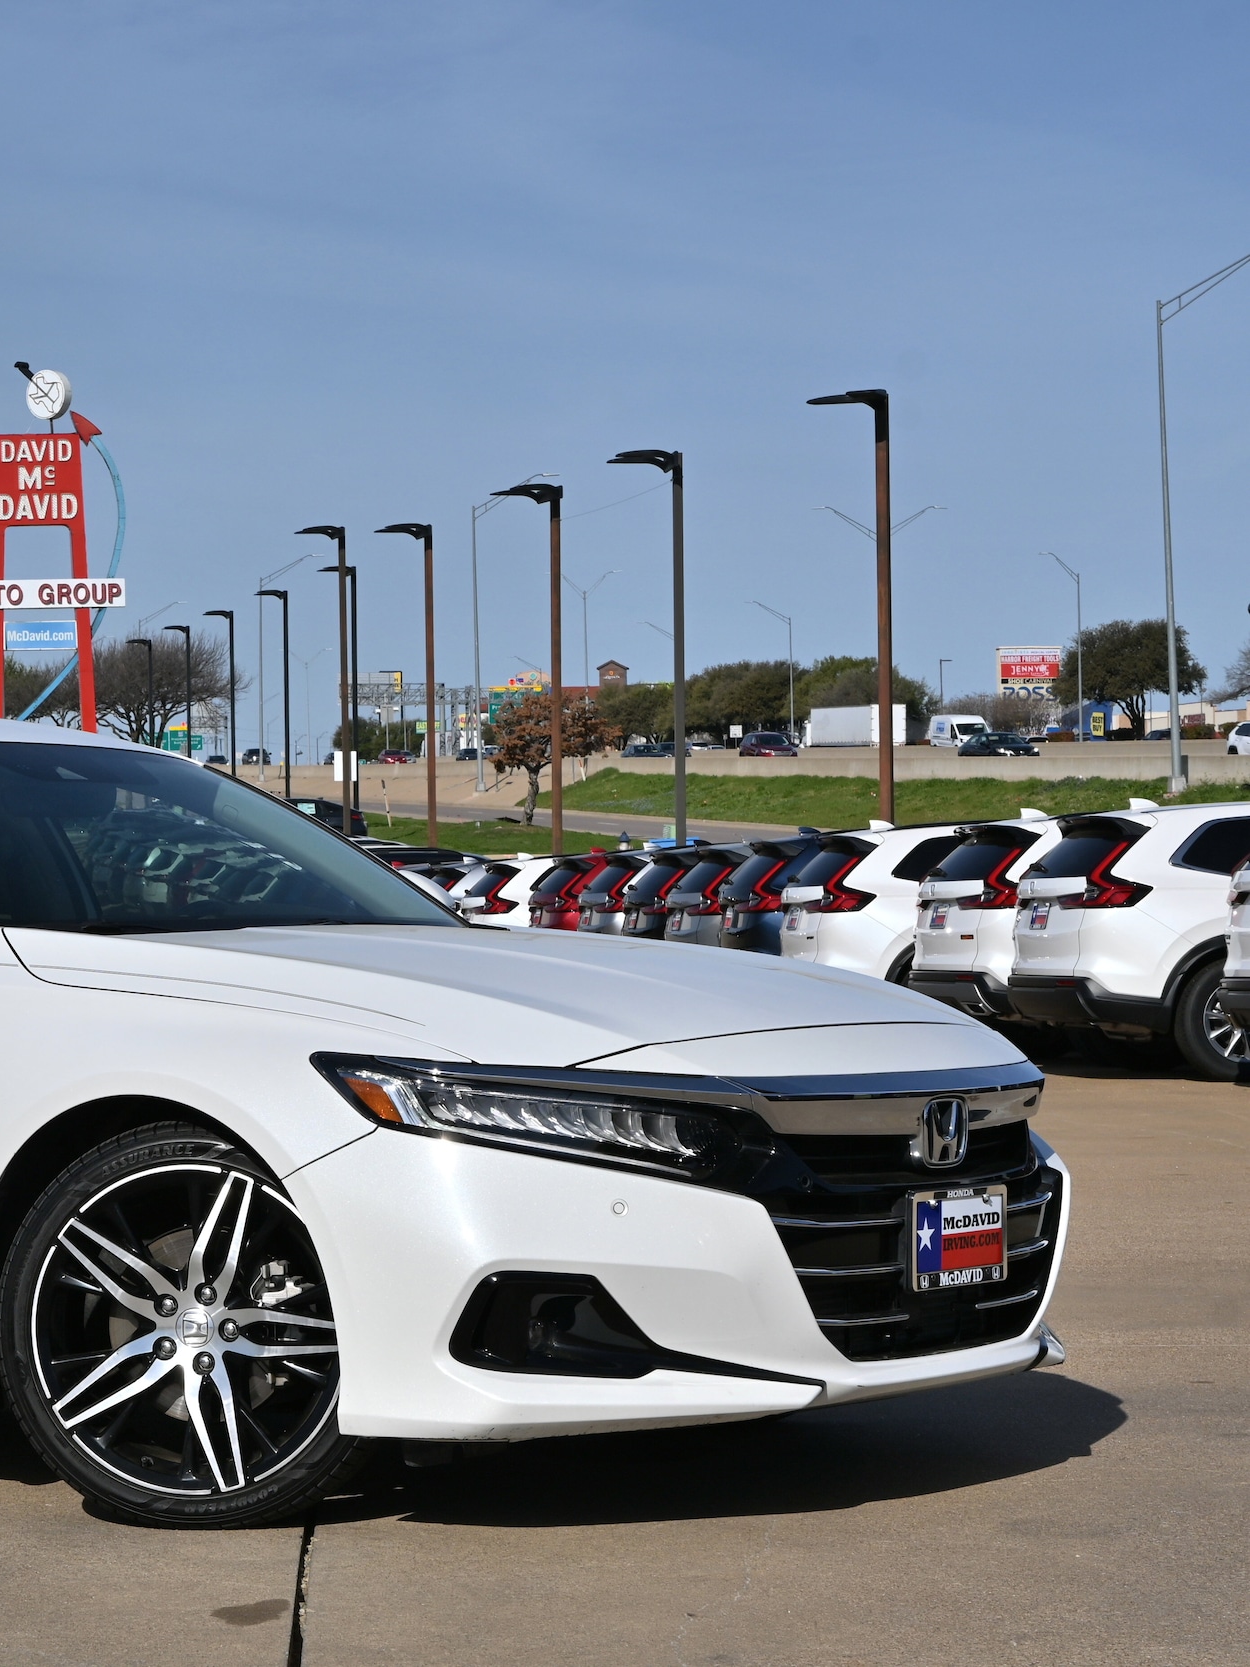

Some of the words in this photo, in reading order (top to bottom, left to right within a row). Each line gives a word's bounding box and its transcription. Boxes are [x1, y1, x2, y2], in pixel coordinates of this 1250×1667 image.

[0, 439, 72, 462] DAVID
[38, 583, 122, 606] GROUP
[7, 630, 74, 642] McDavid.com
[1092, 715, 1104, 724] BEST
[1092, 724, 1102, 732] BUY
[101, 1144, 195, 1177] ASSURANCE
[947, 1189, 974, 1198] HONDA
[943, 1212, 1000, 1230] McDAVID
[943, 1232, 1000, 1251] IRVING.COM
[939, 1268, 983, 1286] McDAVID
